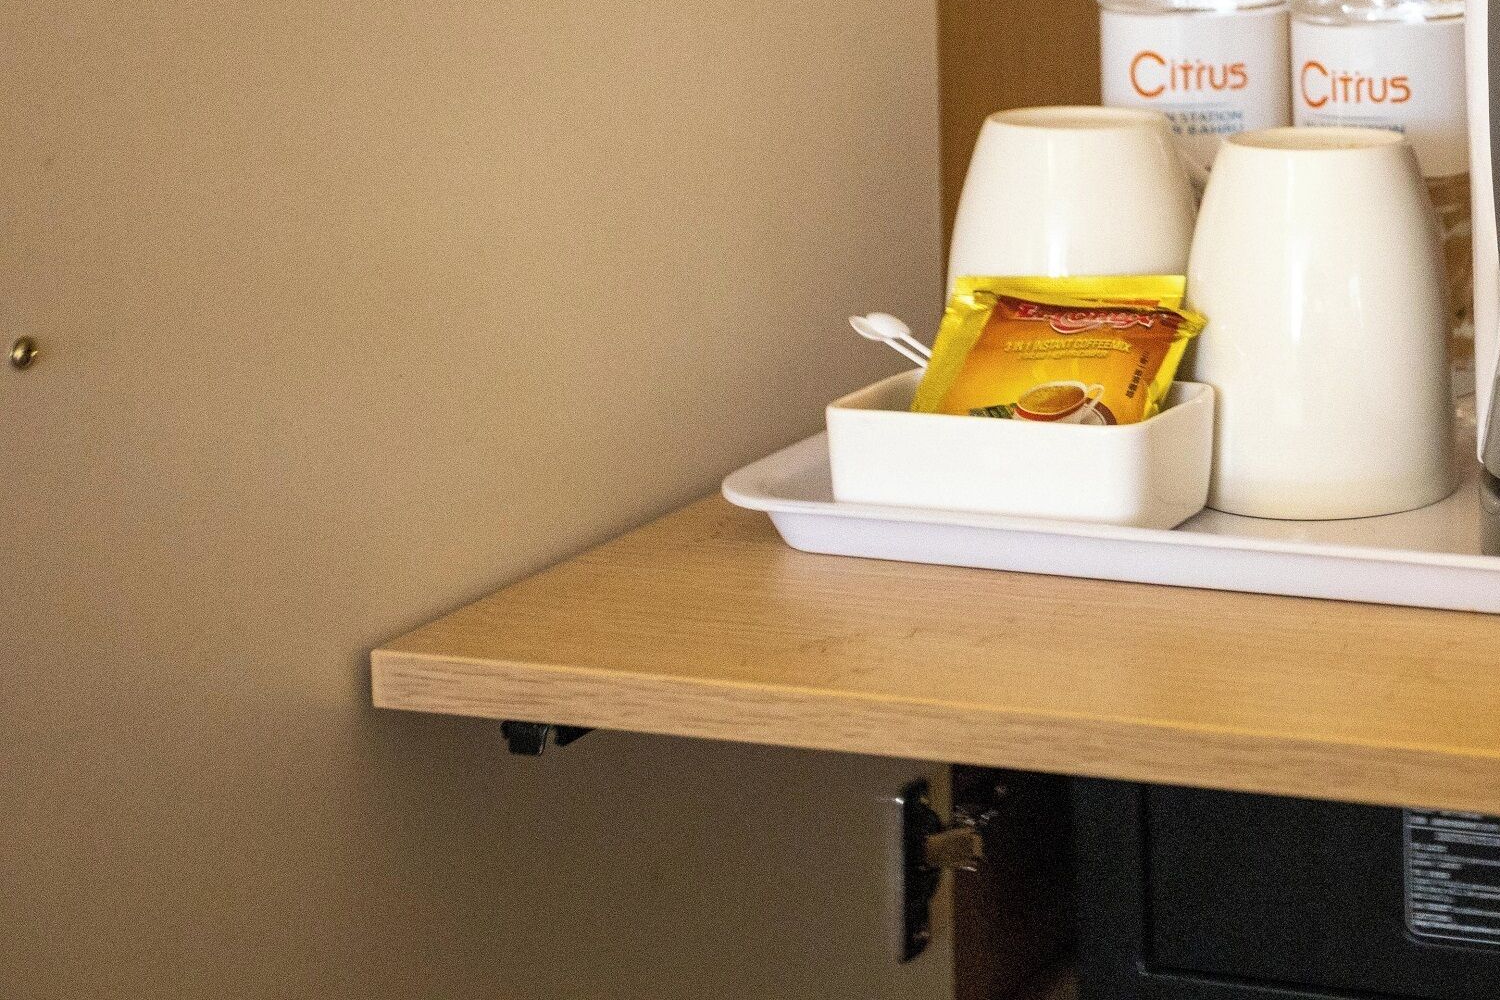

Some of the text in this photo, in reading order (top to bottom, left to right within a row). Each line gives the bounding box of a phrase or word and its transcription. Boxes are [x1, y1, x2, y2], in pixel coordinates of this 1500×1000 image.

[1129, 50, 1248, 98] Citrus
[1301, 60, 1412, 108] Citrus
[1179, 111, 1243, 122] STATION
[1033, 339, 1074, 352] INSTANT
